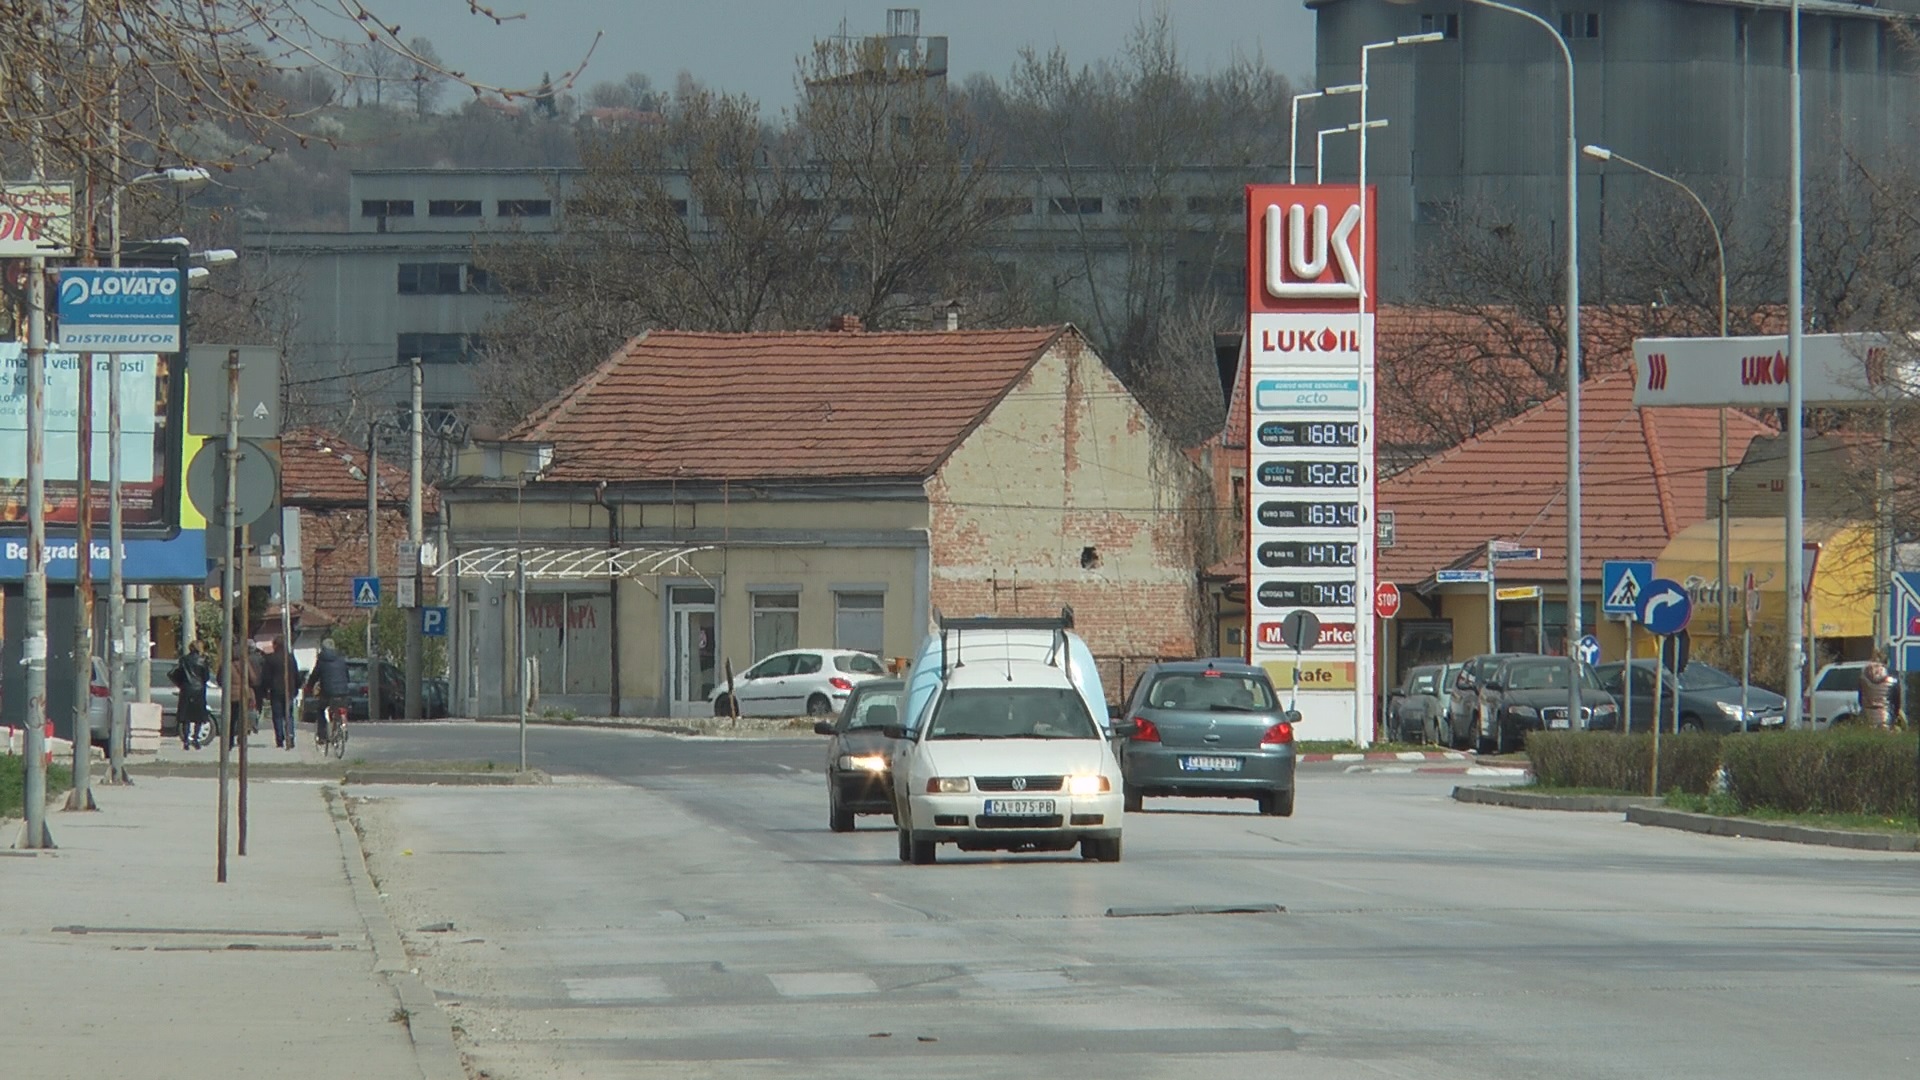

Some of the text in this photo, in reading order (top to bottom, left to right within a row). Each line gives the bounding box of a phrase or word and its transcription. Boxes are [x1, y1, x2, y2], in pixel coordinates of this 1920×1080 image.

[91, 277, 177, 295] LOVATO
[90, 294, 173, 305] AUTOGAS
[65, 334, 174, 343] DISTRIBUTOR
[1262, 326, 1360, 352] LUKOIL
[96, 360, 144, 372] raosti
[13, 373, 52, 386] krit
[1296, 392, 1328, 404] ecto
[1263, 426, 1284, 434] ecto
[1265, 466, 1285, 474] ecto
[6, 543, 110, 563] Begradka
[1377, 593, 1397, 606] STOP
[423, 610, 443, 633] P
[1318, 627, 1357, 642] arket
